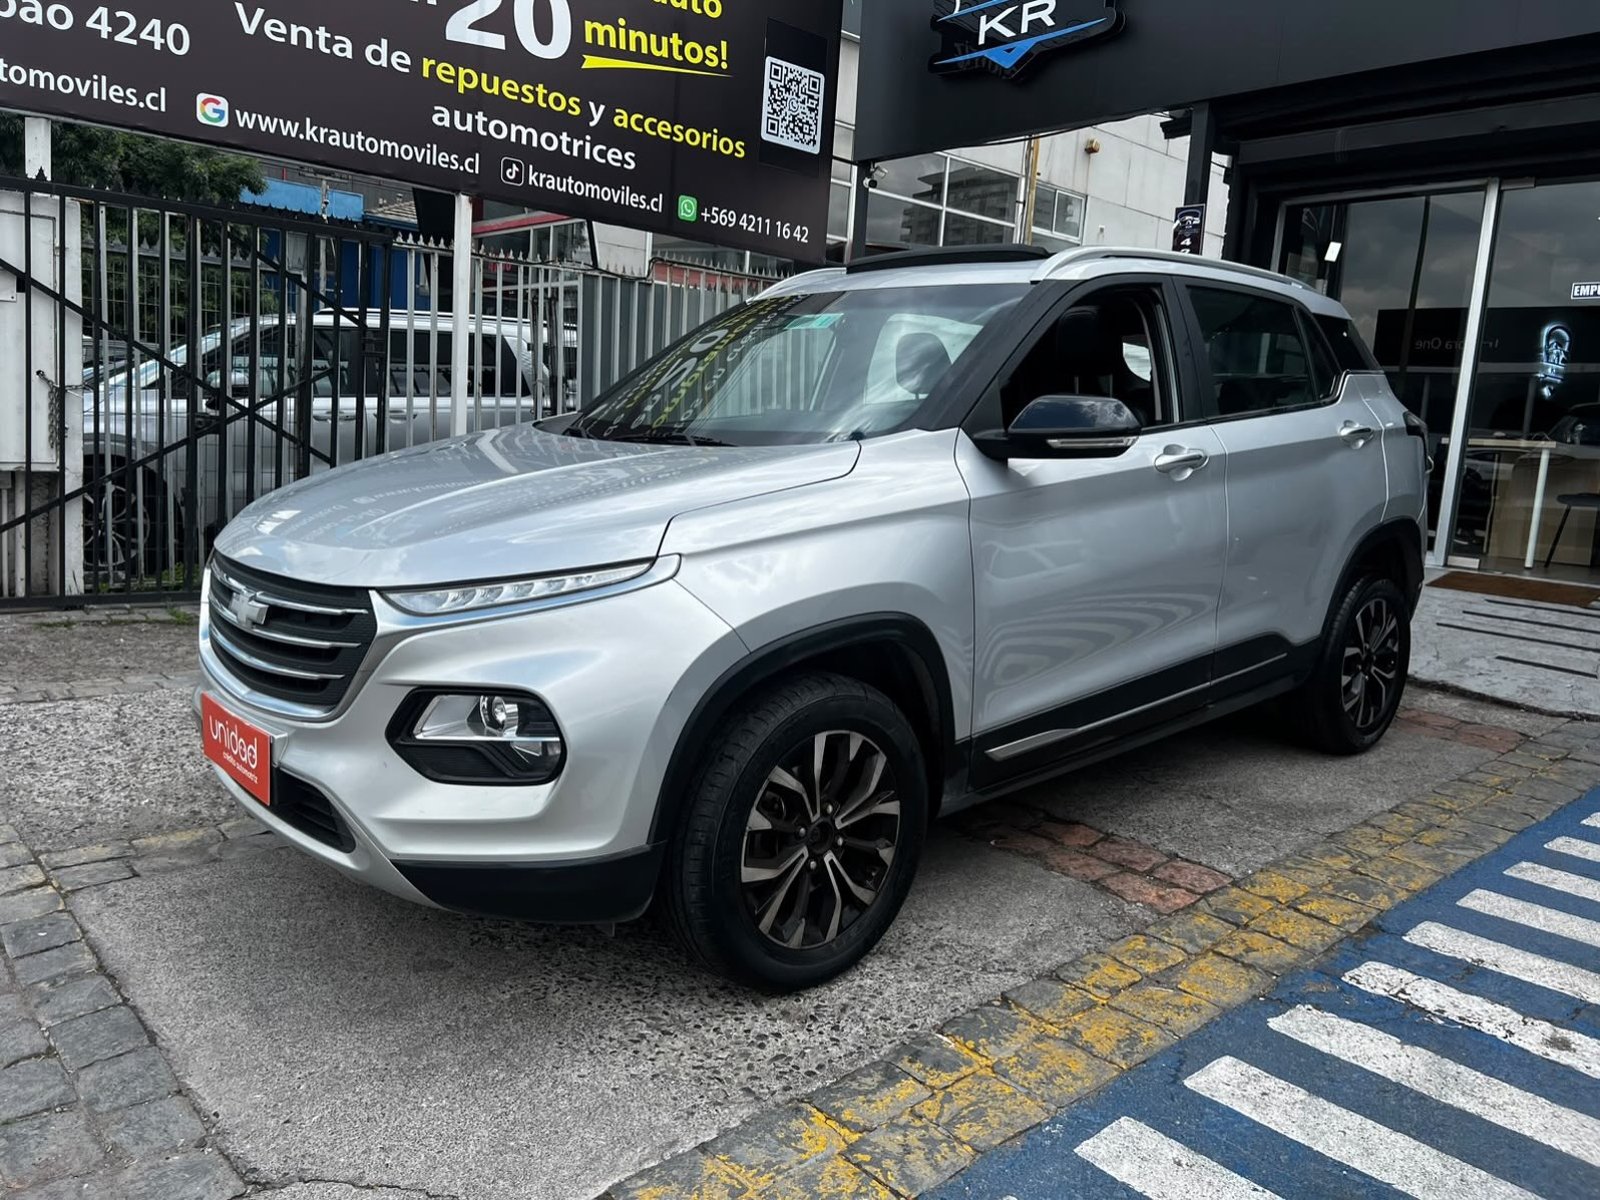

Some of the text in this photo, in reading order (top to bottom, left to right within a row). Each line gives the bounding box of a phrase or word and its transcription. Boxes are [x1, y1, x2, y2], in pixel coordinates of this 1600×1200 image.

[86, 6, 190, 56] 4240
[445, 0, 572, 59] 20
[585, 18, 728, 70] minutos!
[978, 0, 1057, 46] KR
[234, 1, 745, 158] Venta de repuestos y accesorios
[235, 109, 480, 175] www.krautomoviles.cl
[431, 105, 636, 170] automotrices
[528, 164, 663, 213] krautomoviles.cl
[700, 206, 809, 244] +569 4211 16 42
[209, 715, 258, 769] unidad
